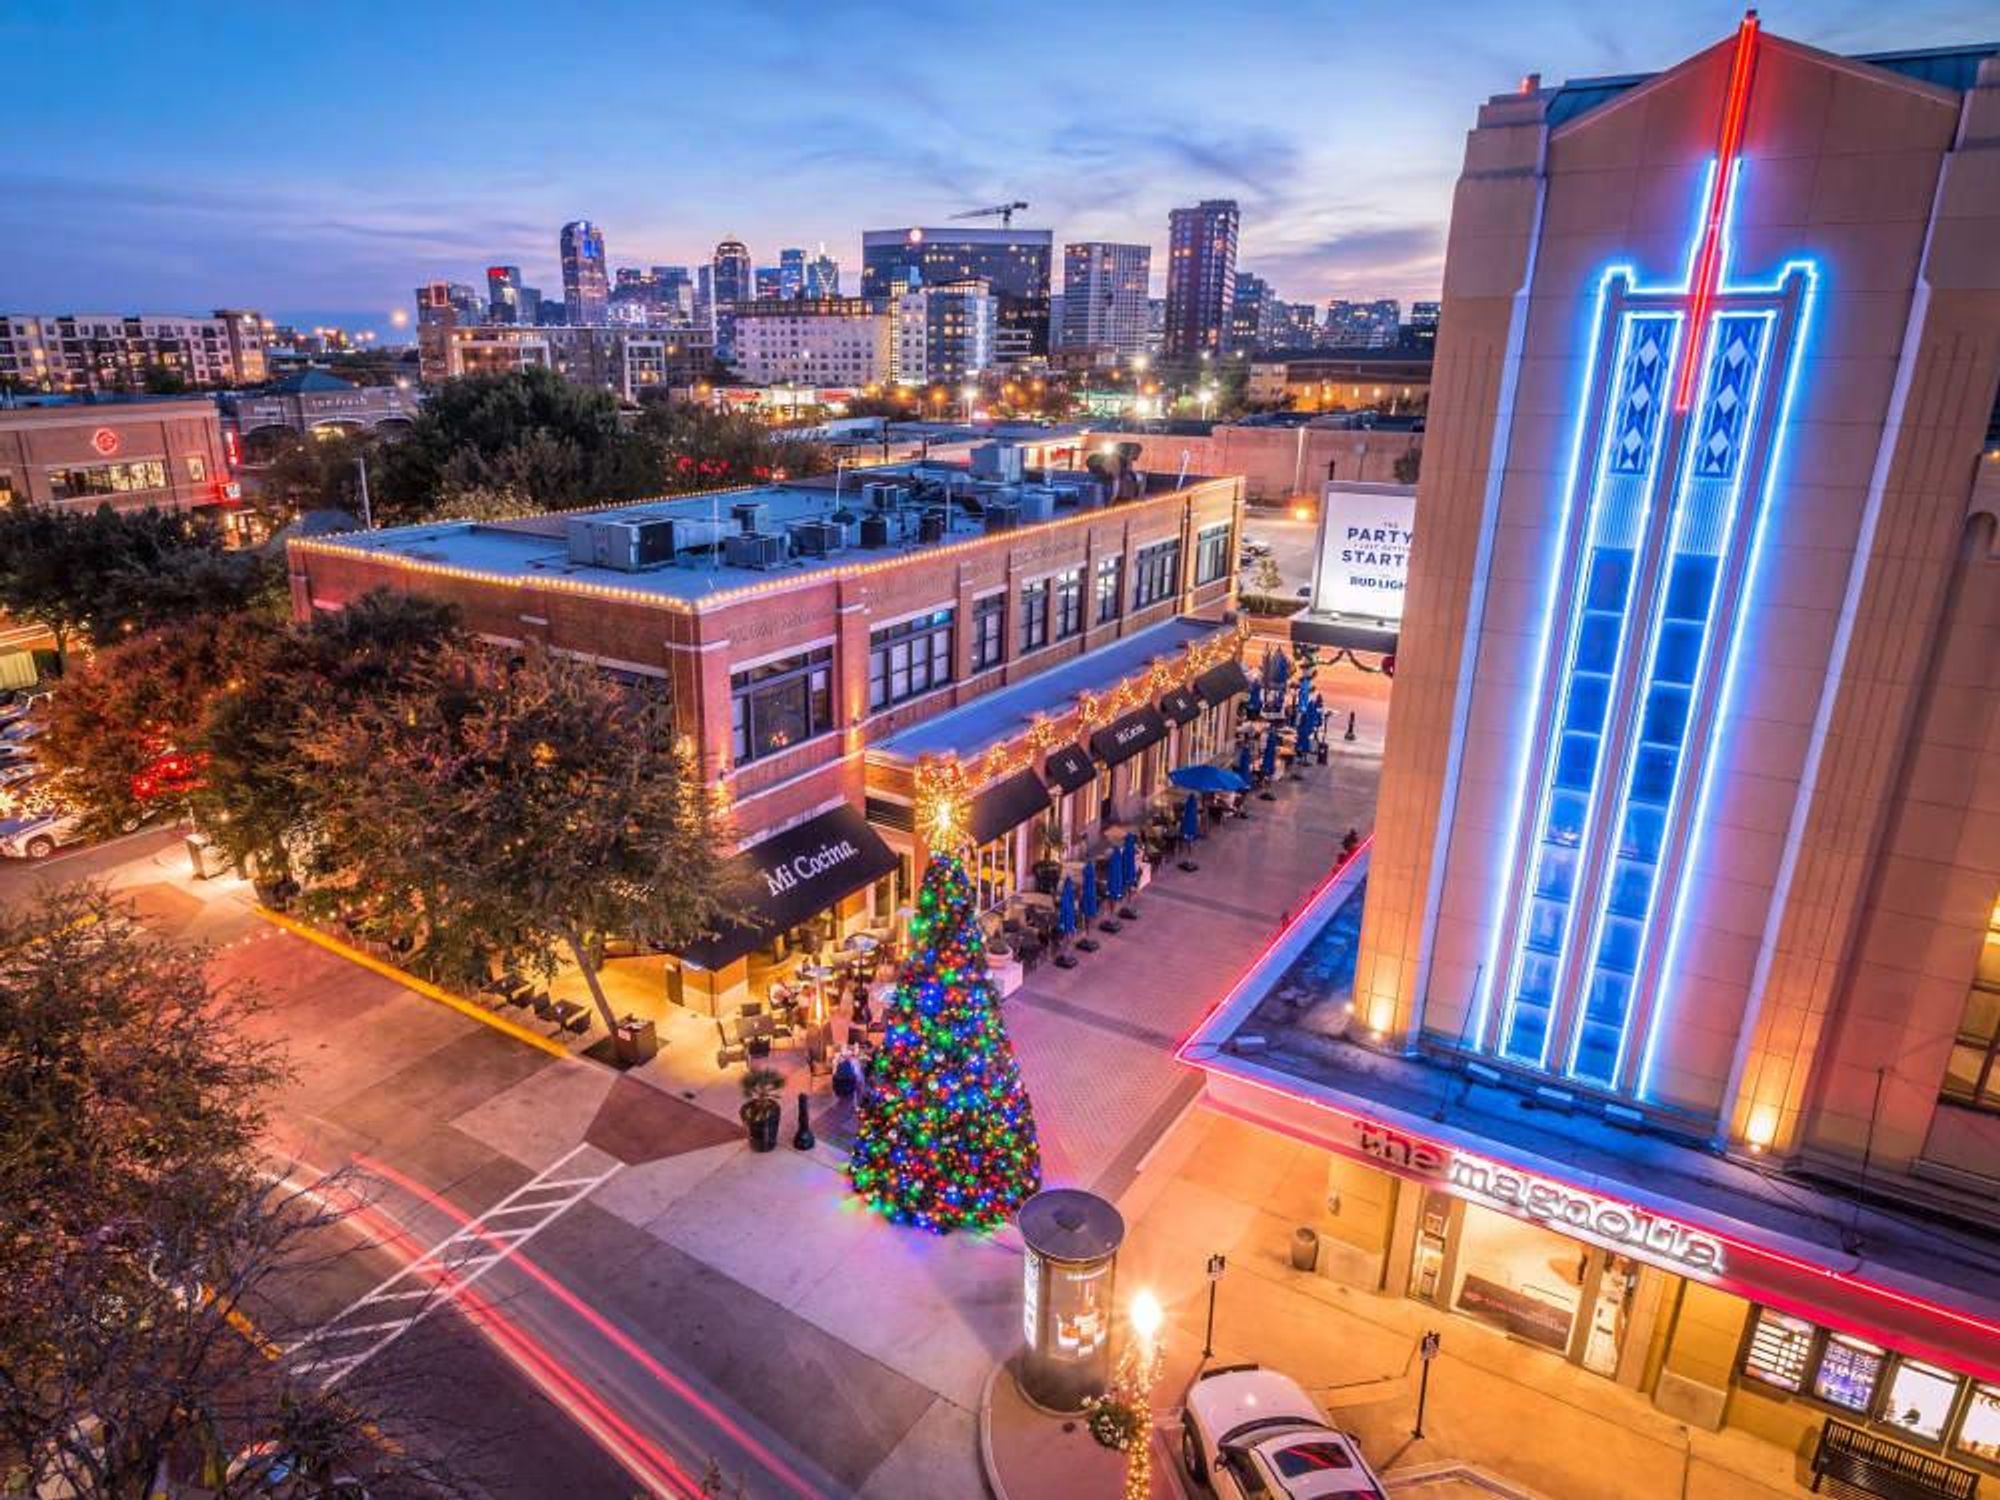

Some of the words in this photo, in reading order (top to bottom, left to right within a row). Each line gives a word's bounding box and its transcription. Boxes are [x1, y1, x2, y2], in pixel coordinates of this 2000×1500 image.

[1348, 528, 1413, 543] PARTY
[1350, 576, 1377, 588] BUD
[762, 864, 798, 897] Mi
[793, 840, 856, 880] Cocina
[1354, 1121, 1443, 1169] the
[1451, 1155, 1726, 1276] magnolia
